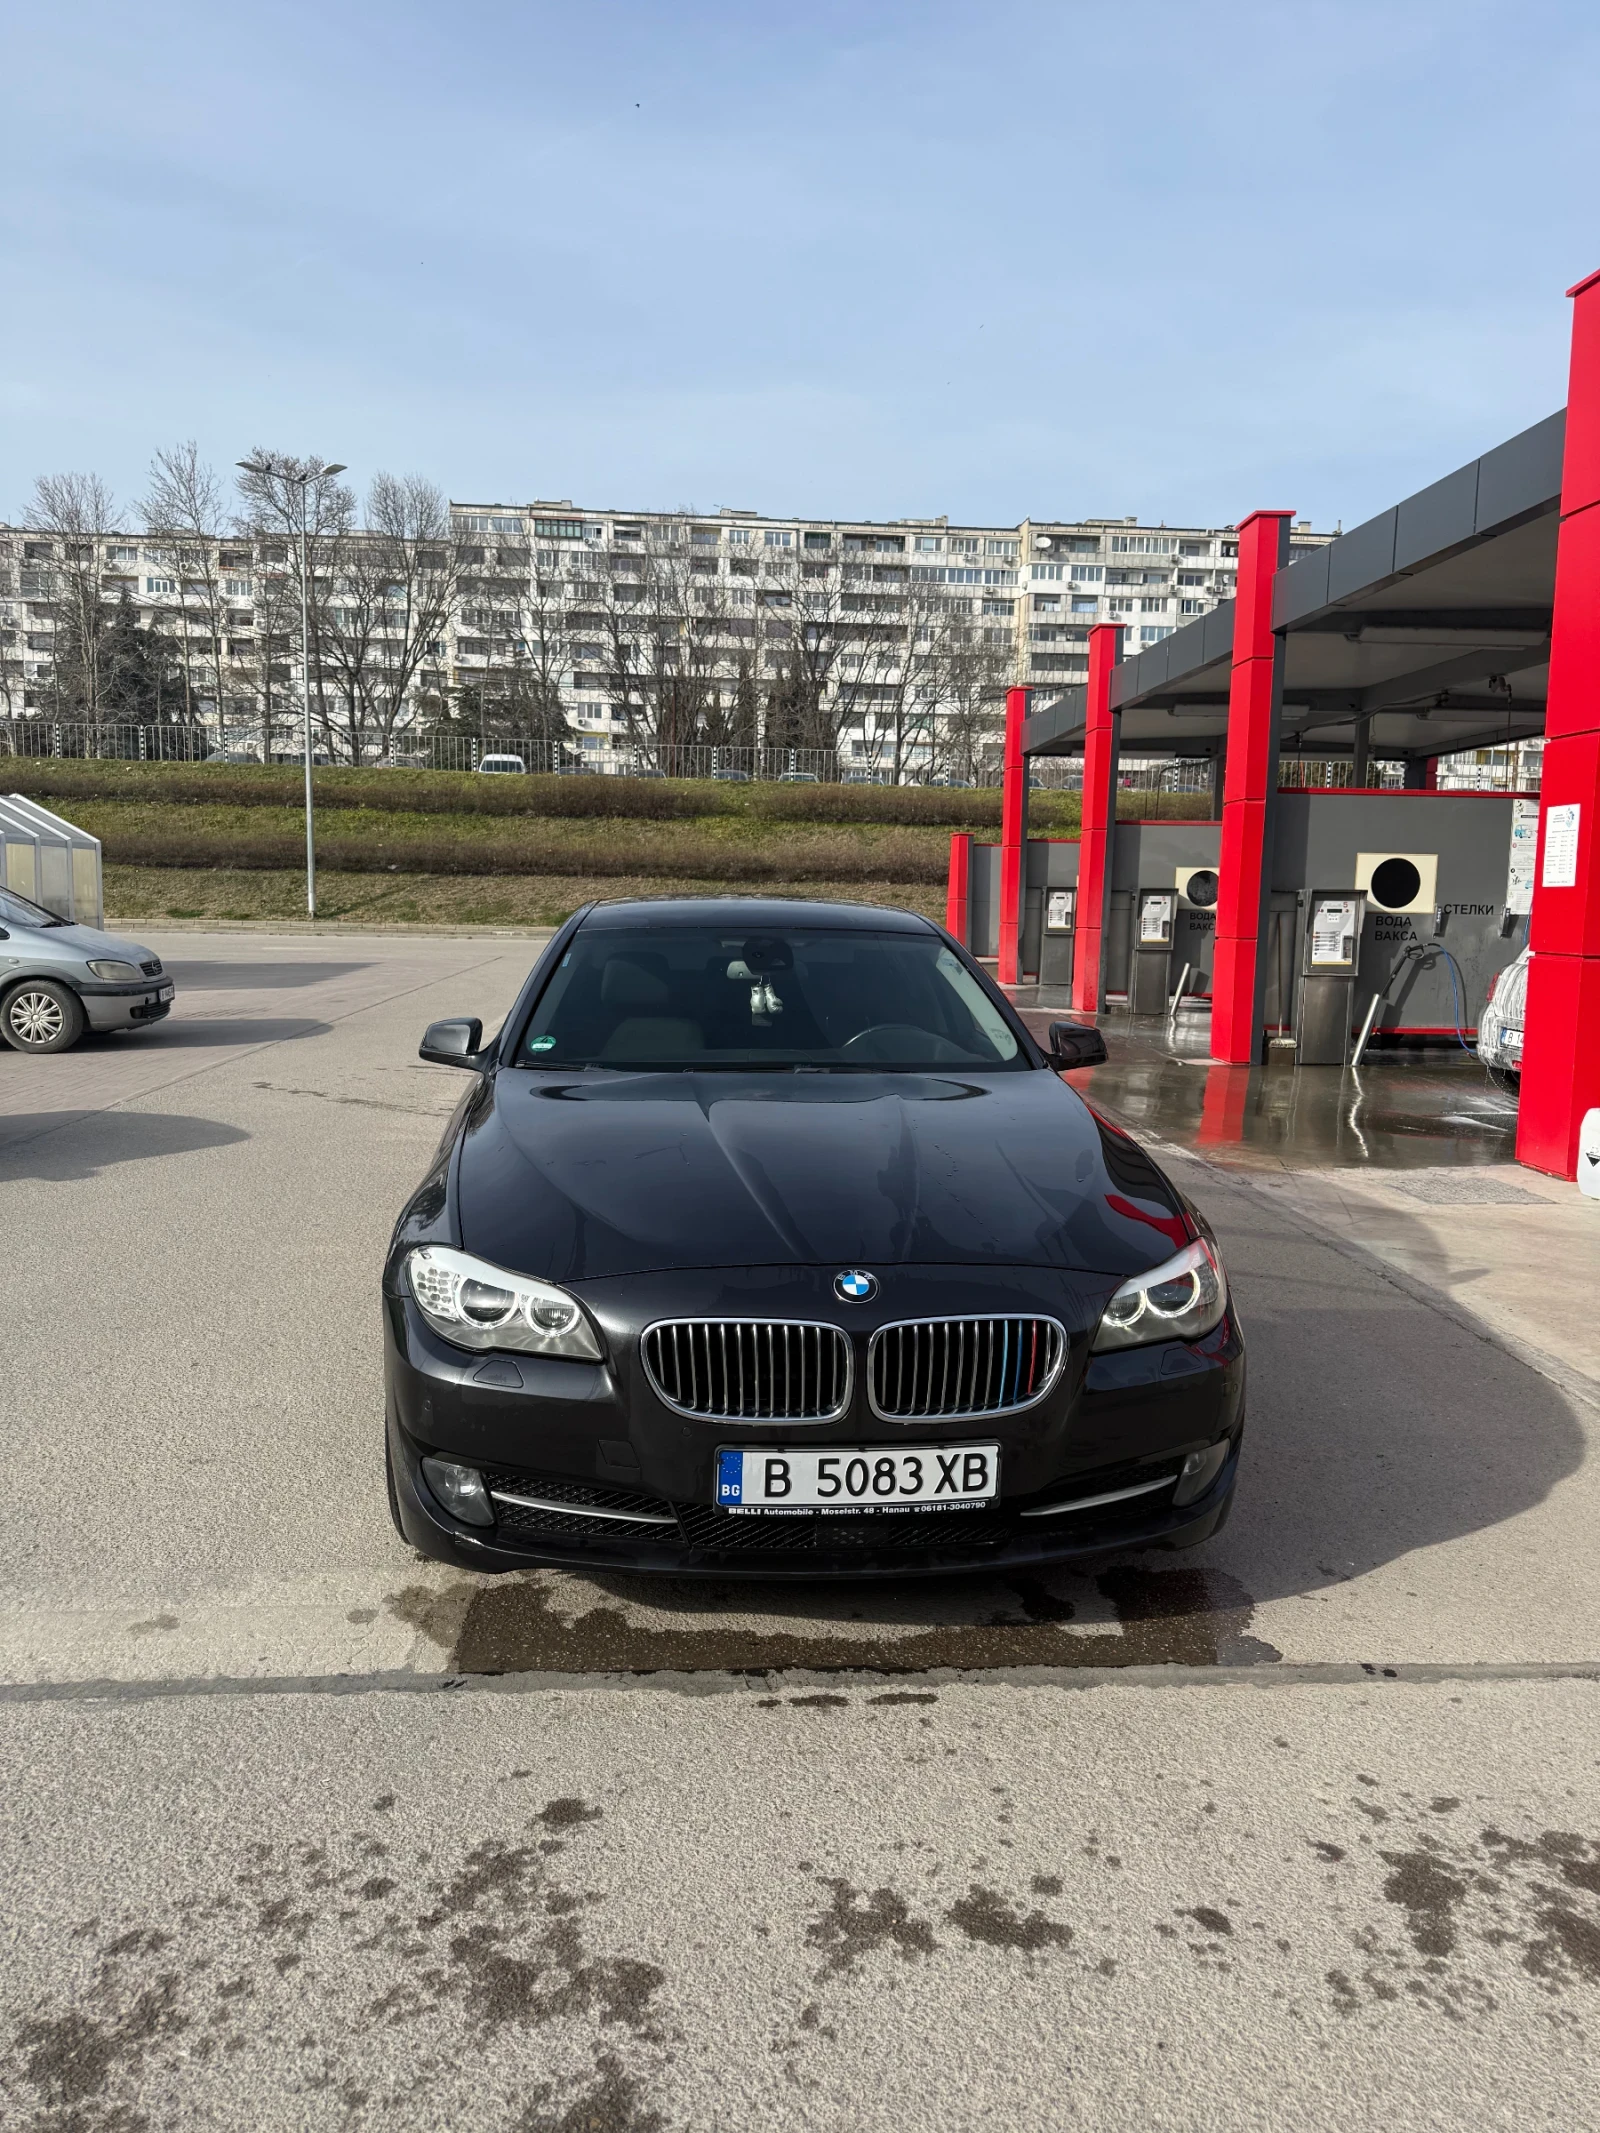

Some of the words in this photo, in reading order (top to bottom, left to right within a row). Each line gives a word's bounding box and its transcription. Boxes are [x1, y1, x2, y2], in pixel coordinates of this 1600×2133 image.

[1443, 903, 1495, 916] СТЕЛКИ
[1189, 912, 1216, 922] ВОДА
[1375, 916, 1412, 928] ВОДА
[1189, 922, 1216, 932] ВАКС
[1374, 930, 1418, 942] ВАКСА
[837, 1269, 873, 1281] BMW
[764, 1458, 792, 1498] B
[817, 1456, 924, 1498] 5083
[934, 1453, 989, 1495] XB
[721, 1484, 741, 1497] BG
[728, 1507, 761, 1515] BELLI
[763, 1508, 814, 1516] Automobile
[821, 1507, 861, 1515] Moselstr.
